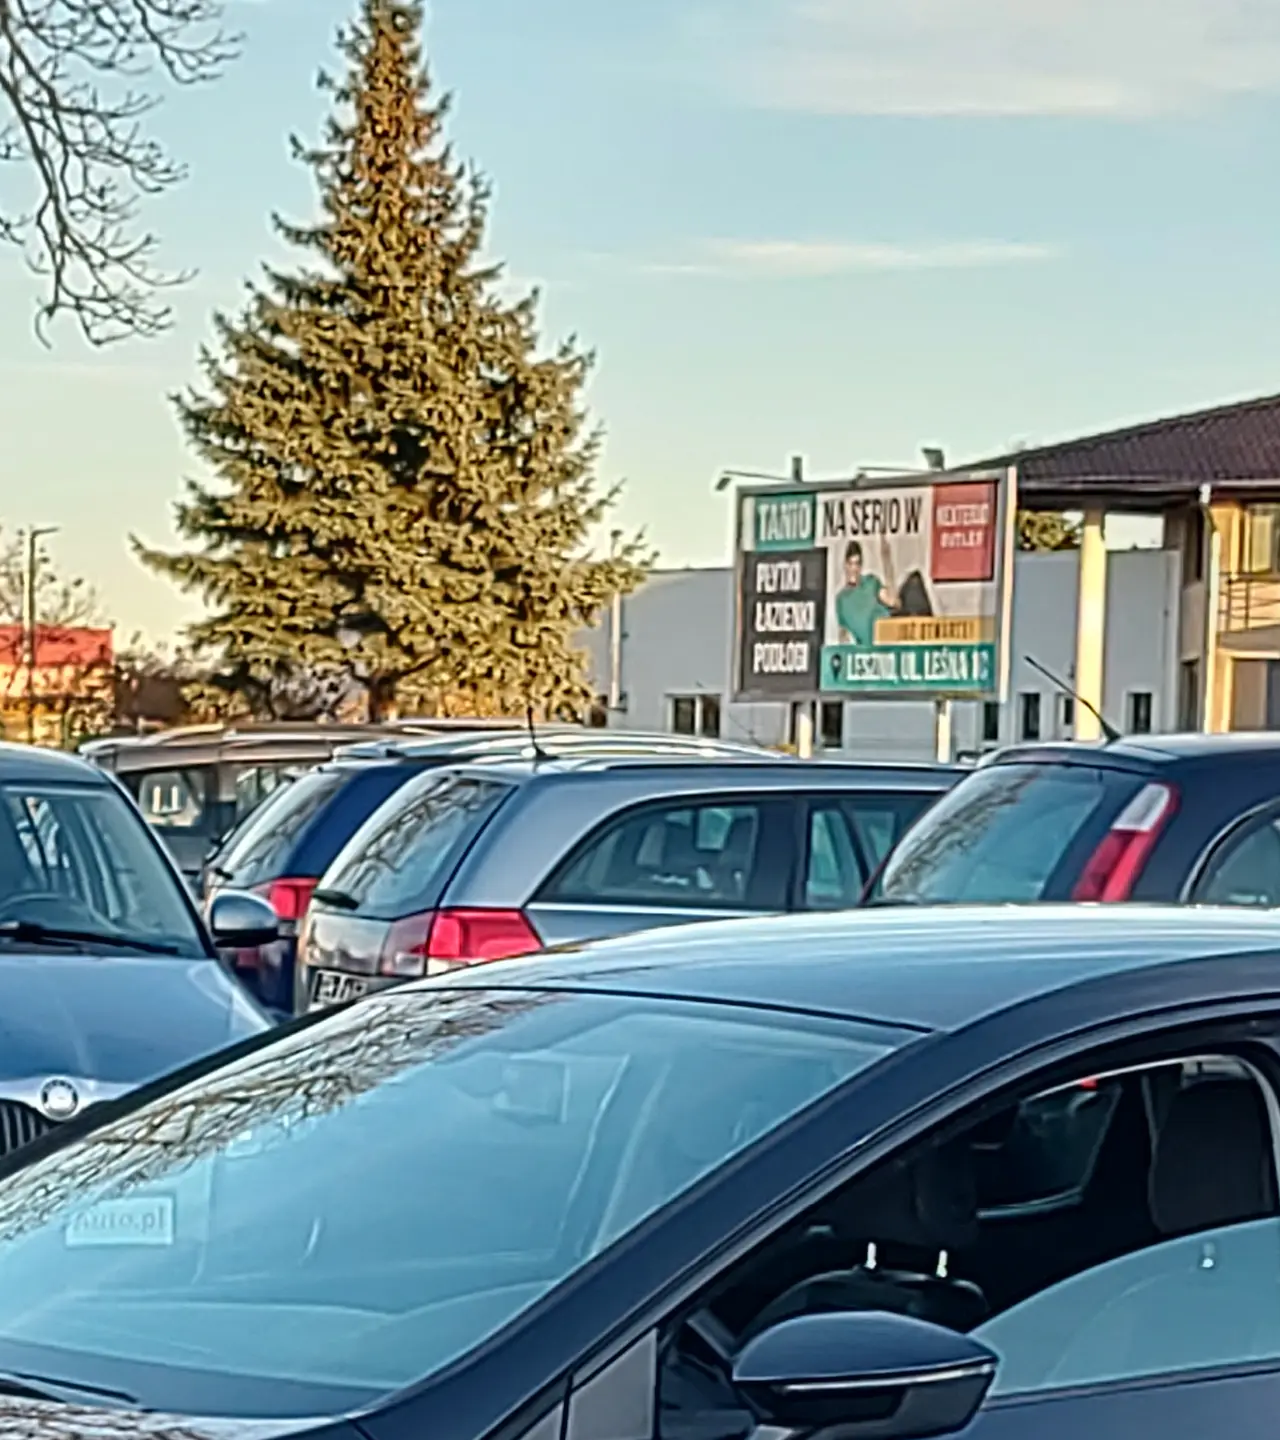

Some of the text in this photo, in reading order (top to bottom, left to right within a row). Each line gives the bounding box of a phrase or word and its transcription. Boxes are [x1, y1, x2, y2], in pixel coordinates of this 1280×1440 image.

[758, 502, 812, 541] TANTO
[823, 496, 922, 537] NA SERIO W
